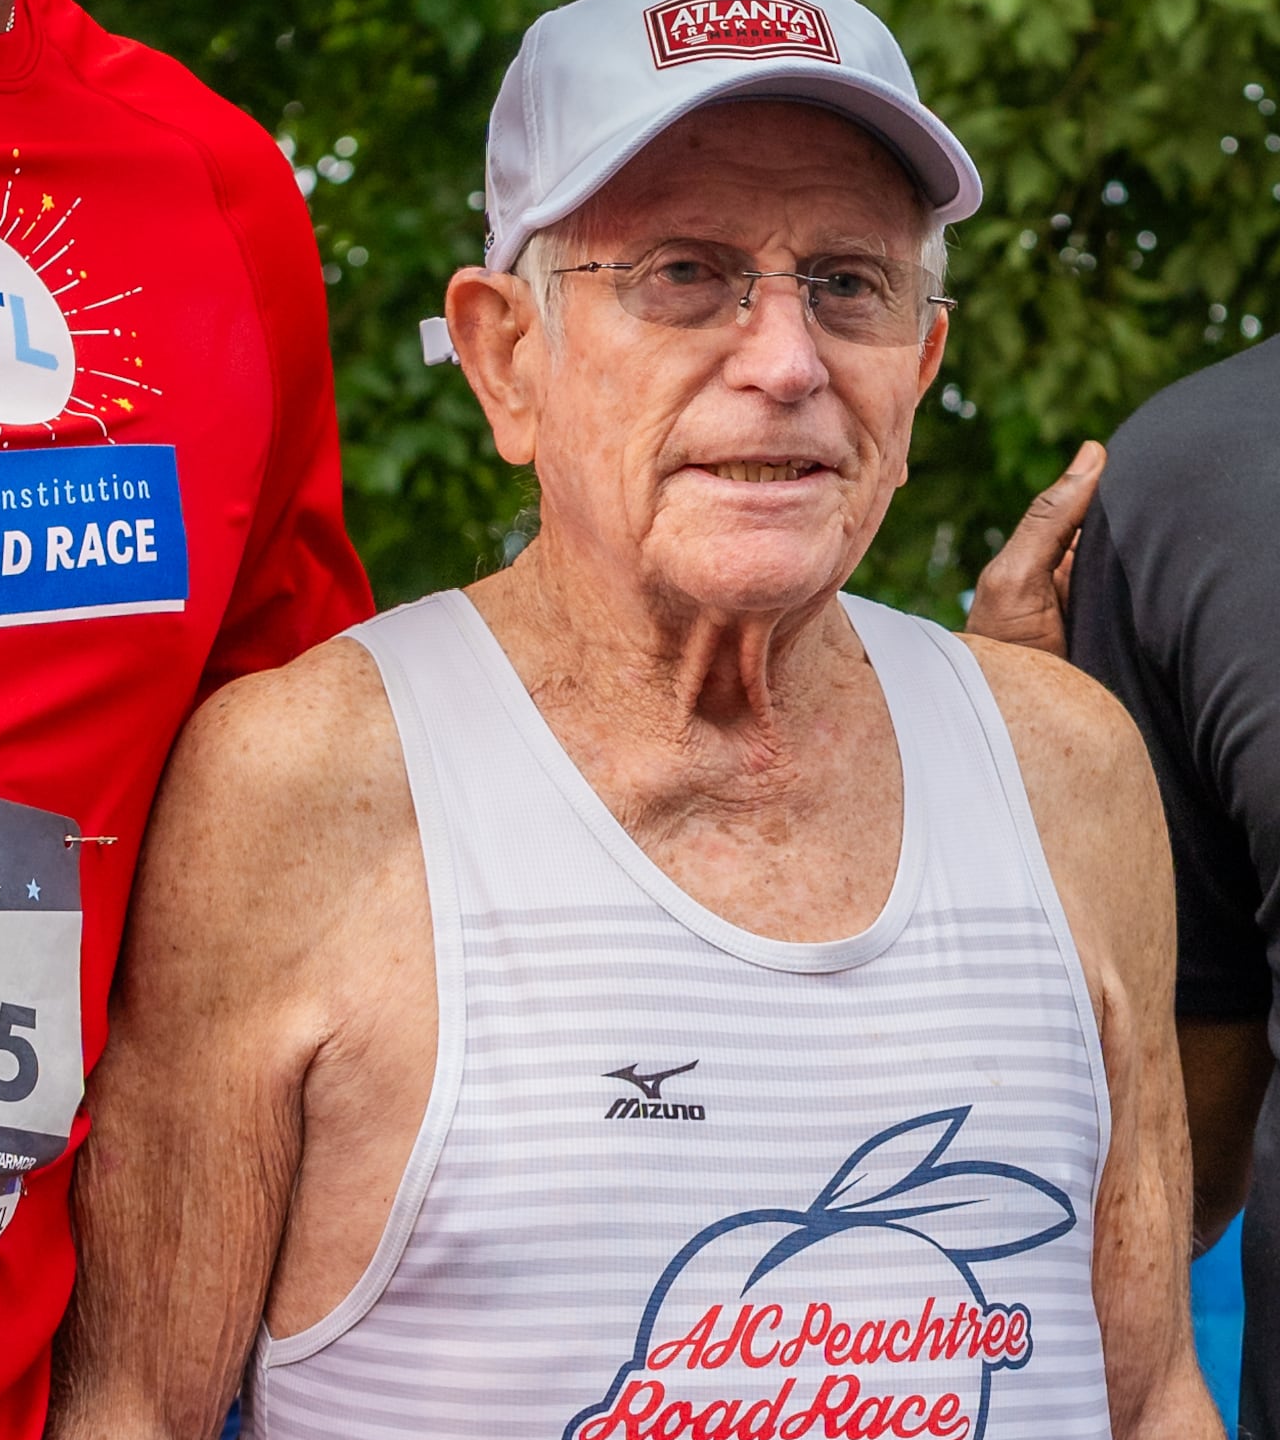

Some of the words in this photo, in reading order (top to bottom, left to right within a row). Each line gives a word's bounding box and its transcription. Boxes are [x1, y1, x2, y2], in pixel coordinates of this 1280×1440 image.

[670, 0, 814, 31] ATLANTA
[671, 20, 747, 41] TRACK
[761, 20, 817, 38] CLUB
[45, 518, 157, 572] RACE
[605, 1098, 706, 1121] MIZUNO
[647, 1303, 783, 1370] AJC
[779, 1296, 1028, 1370] Peachtree
